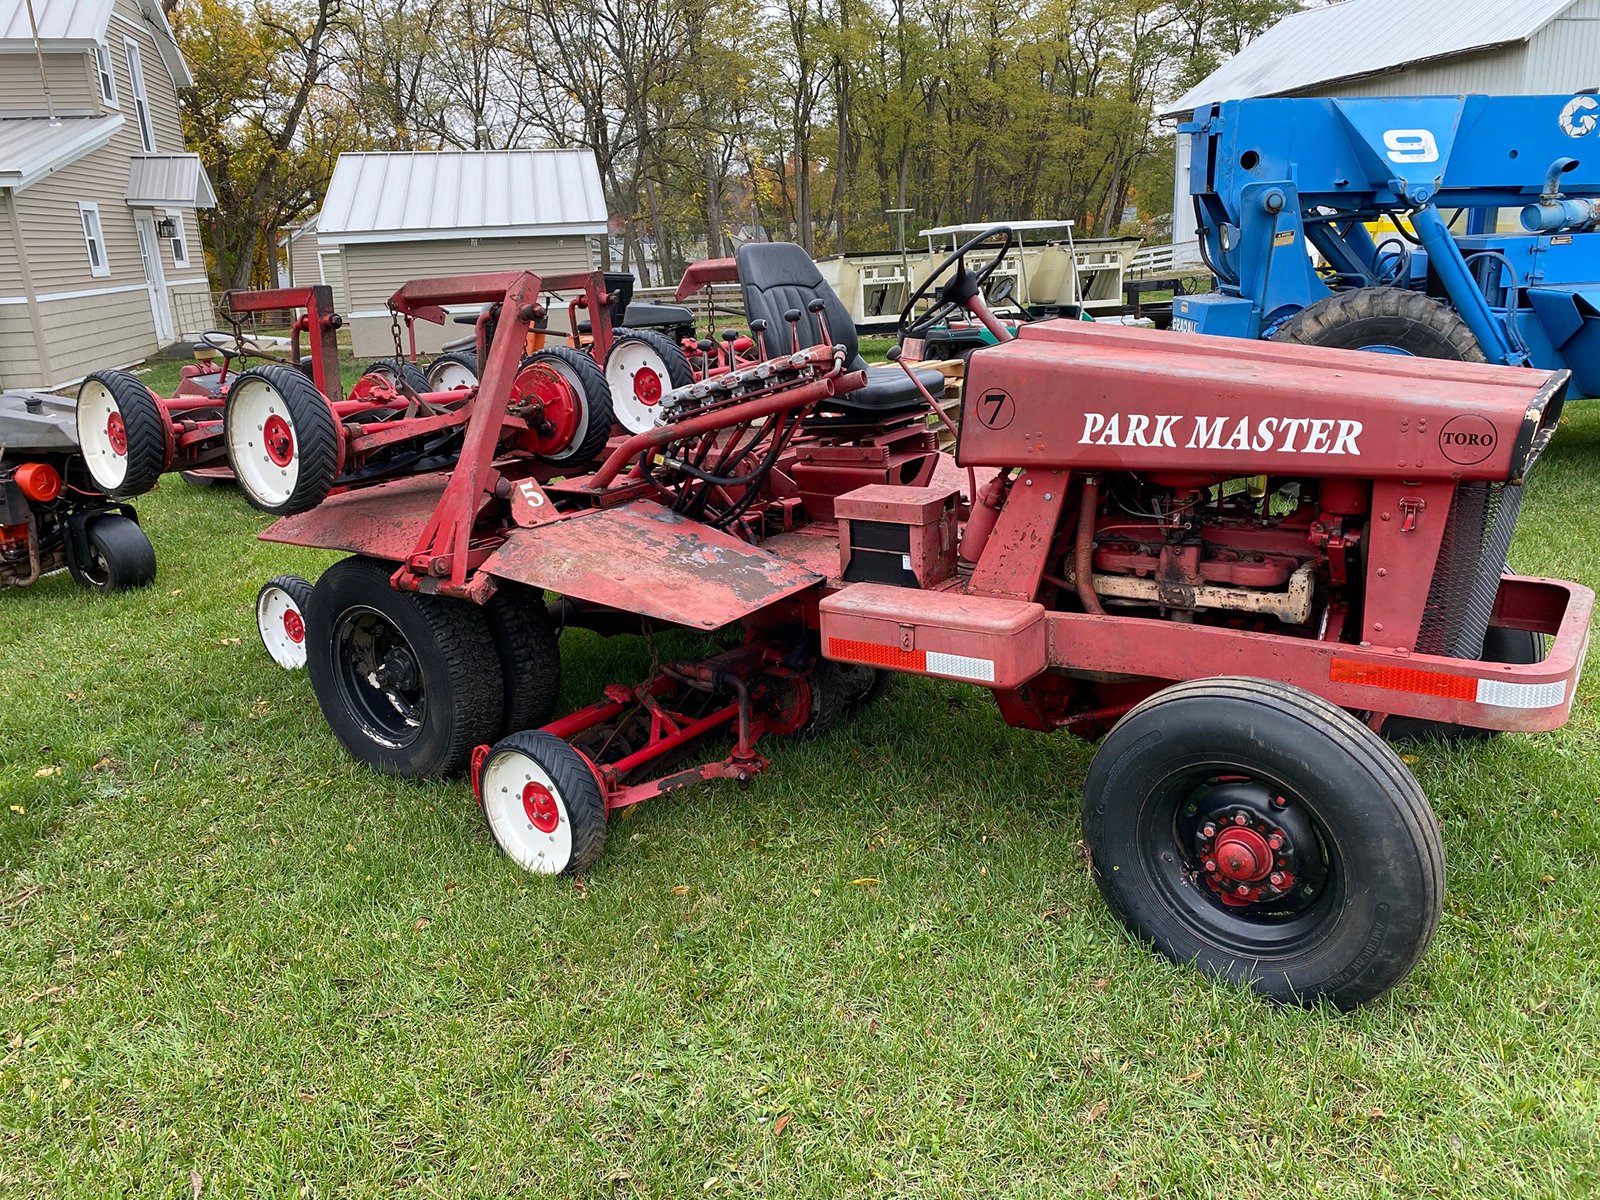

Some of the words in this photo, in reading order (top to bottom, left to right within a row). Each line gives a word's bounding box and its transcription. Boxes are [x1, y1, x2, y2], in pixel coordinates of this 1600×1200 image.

[1383, 129, 1440, 164] 9
[984, 394, 1007, 425] 7
[1077, 412, 1184, 449] PARK
[1184, 415, 1364, 456] MASTER
[1443, 432, 1493, 447] TORO
[519, 480, 544, 507] 5
